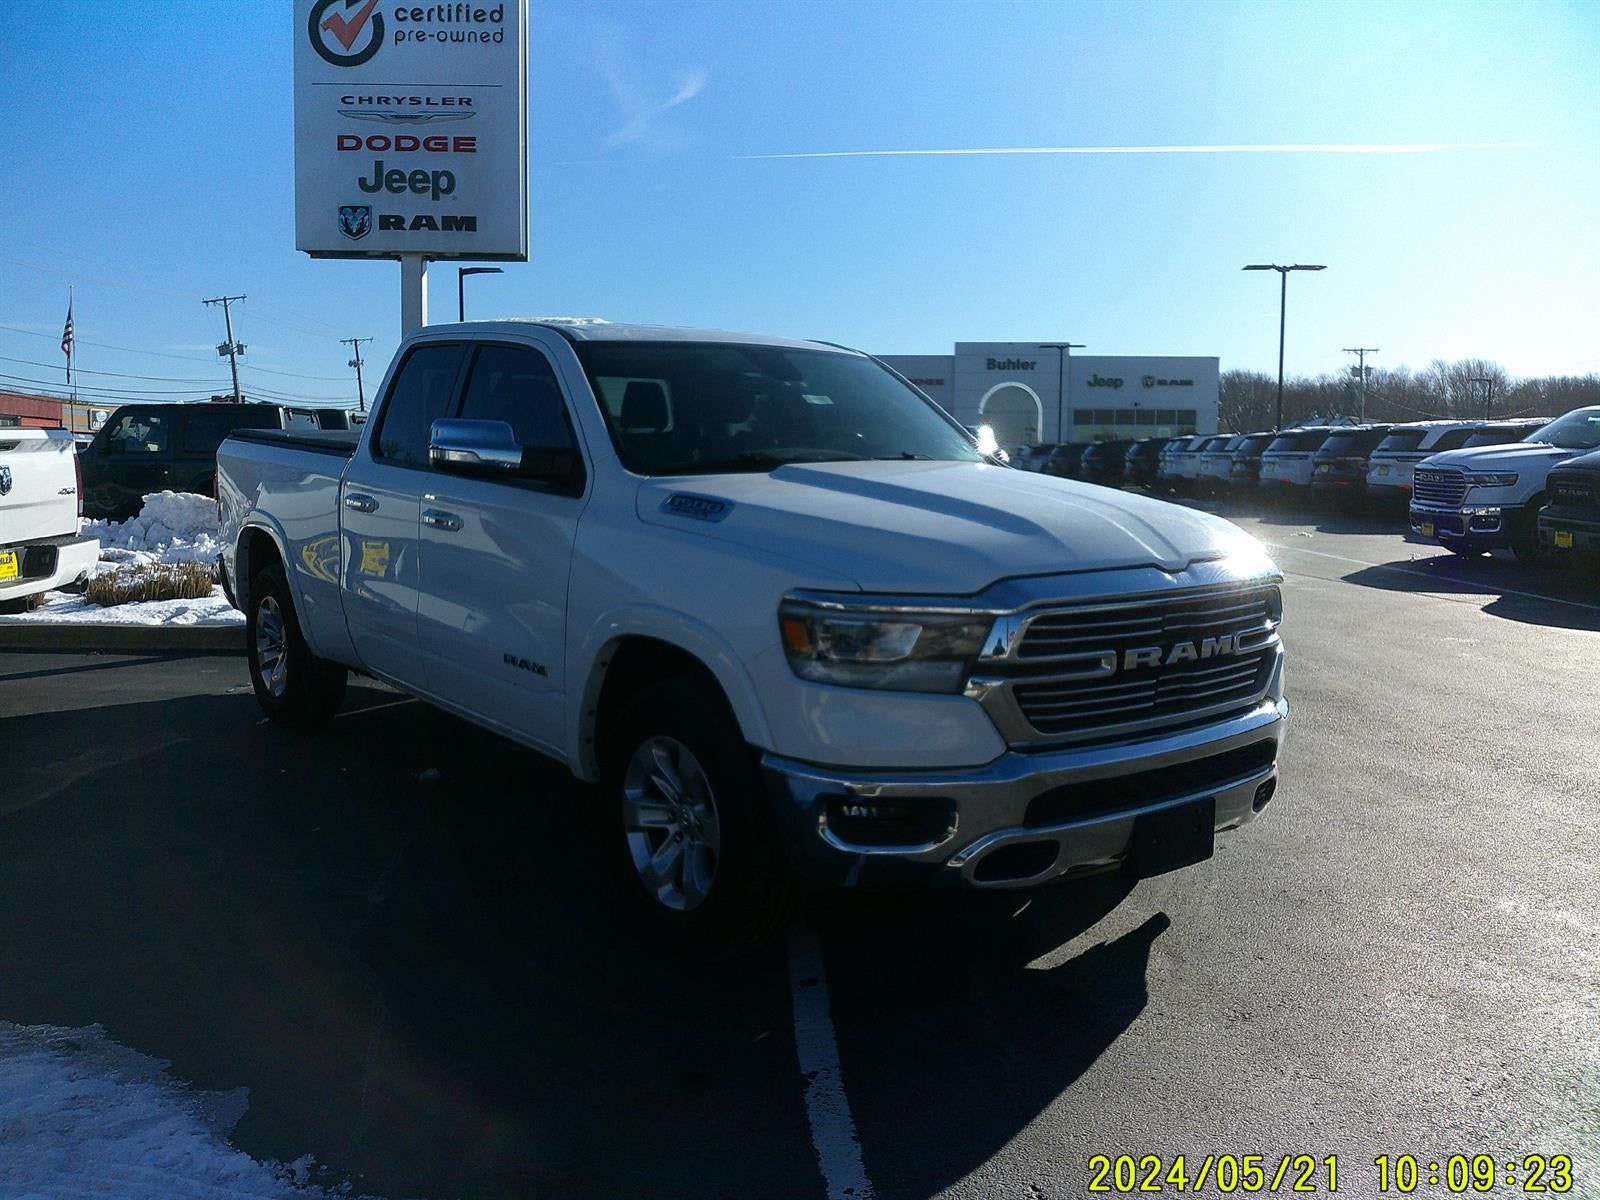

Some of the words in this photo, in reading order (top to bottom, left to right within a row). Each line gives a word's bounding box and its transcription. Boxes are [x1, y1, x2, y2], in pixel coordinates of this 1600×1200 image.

[394, 4, 504, 23] certified
[394, 28, 504, 46] pre-owned
[340, 95, 473, 106] CHRYSLER
[337, 135, 477, 152] DODGE
[358, 160, 456, 201] Jeep
[378, 214, 477, 232] RAM
[986, 358, 1037, 371] Buhler
[1087, 374, 1124, 390] Jeep
[1124, 634, 1232, 670] RAM
[503, 653, 548, 677] RAM
